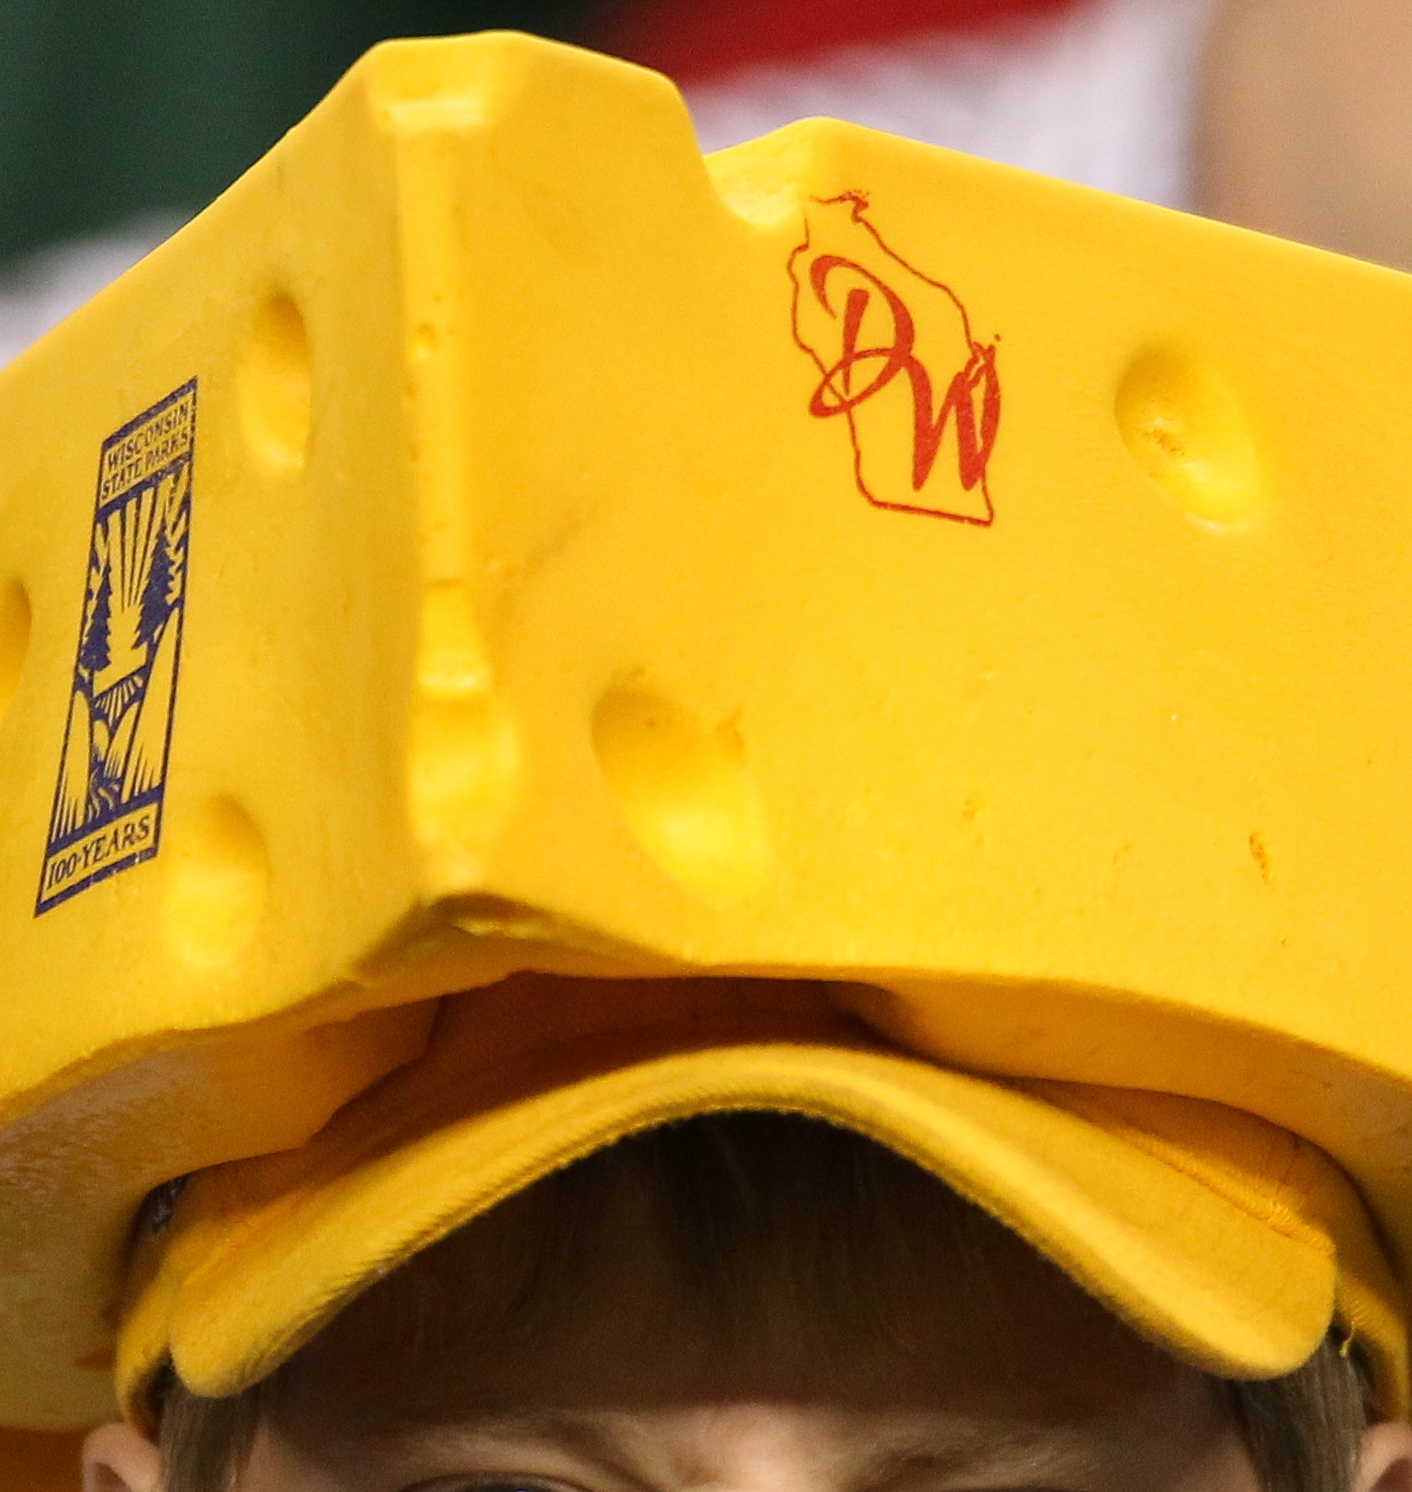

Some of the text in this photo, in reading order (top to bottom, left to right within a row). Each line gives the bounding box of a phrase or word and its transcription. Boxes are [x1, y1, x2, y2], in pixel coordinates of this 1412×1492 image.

[100, 427, 189, 500] STATE PARKS
[106, 399, 191, 474] WISCONSIN
